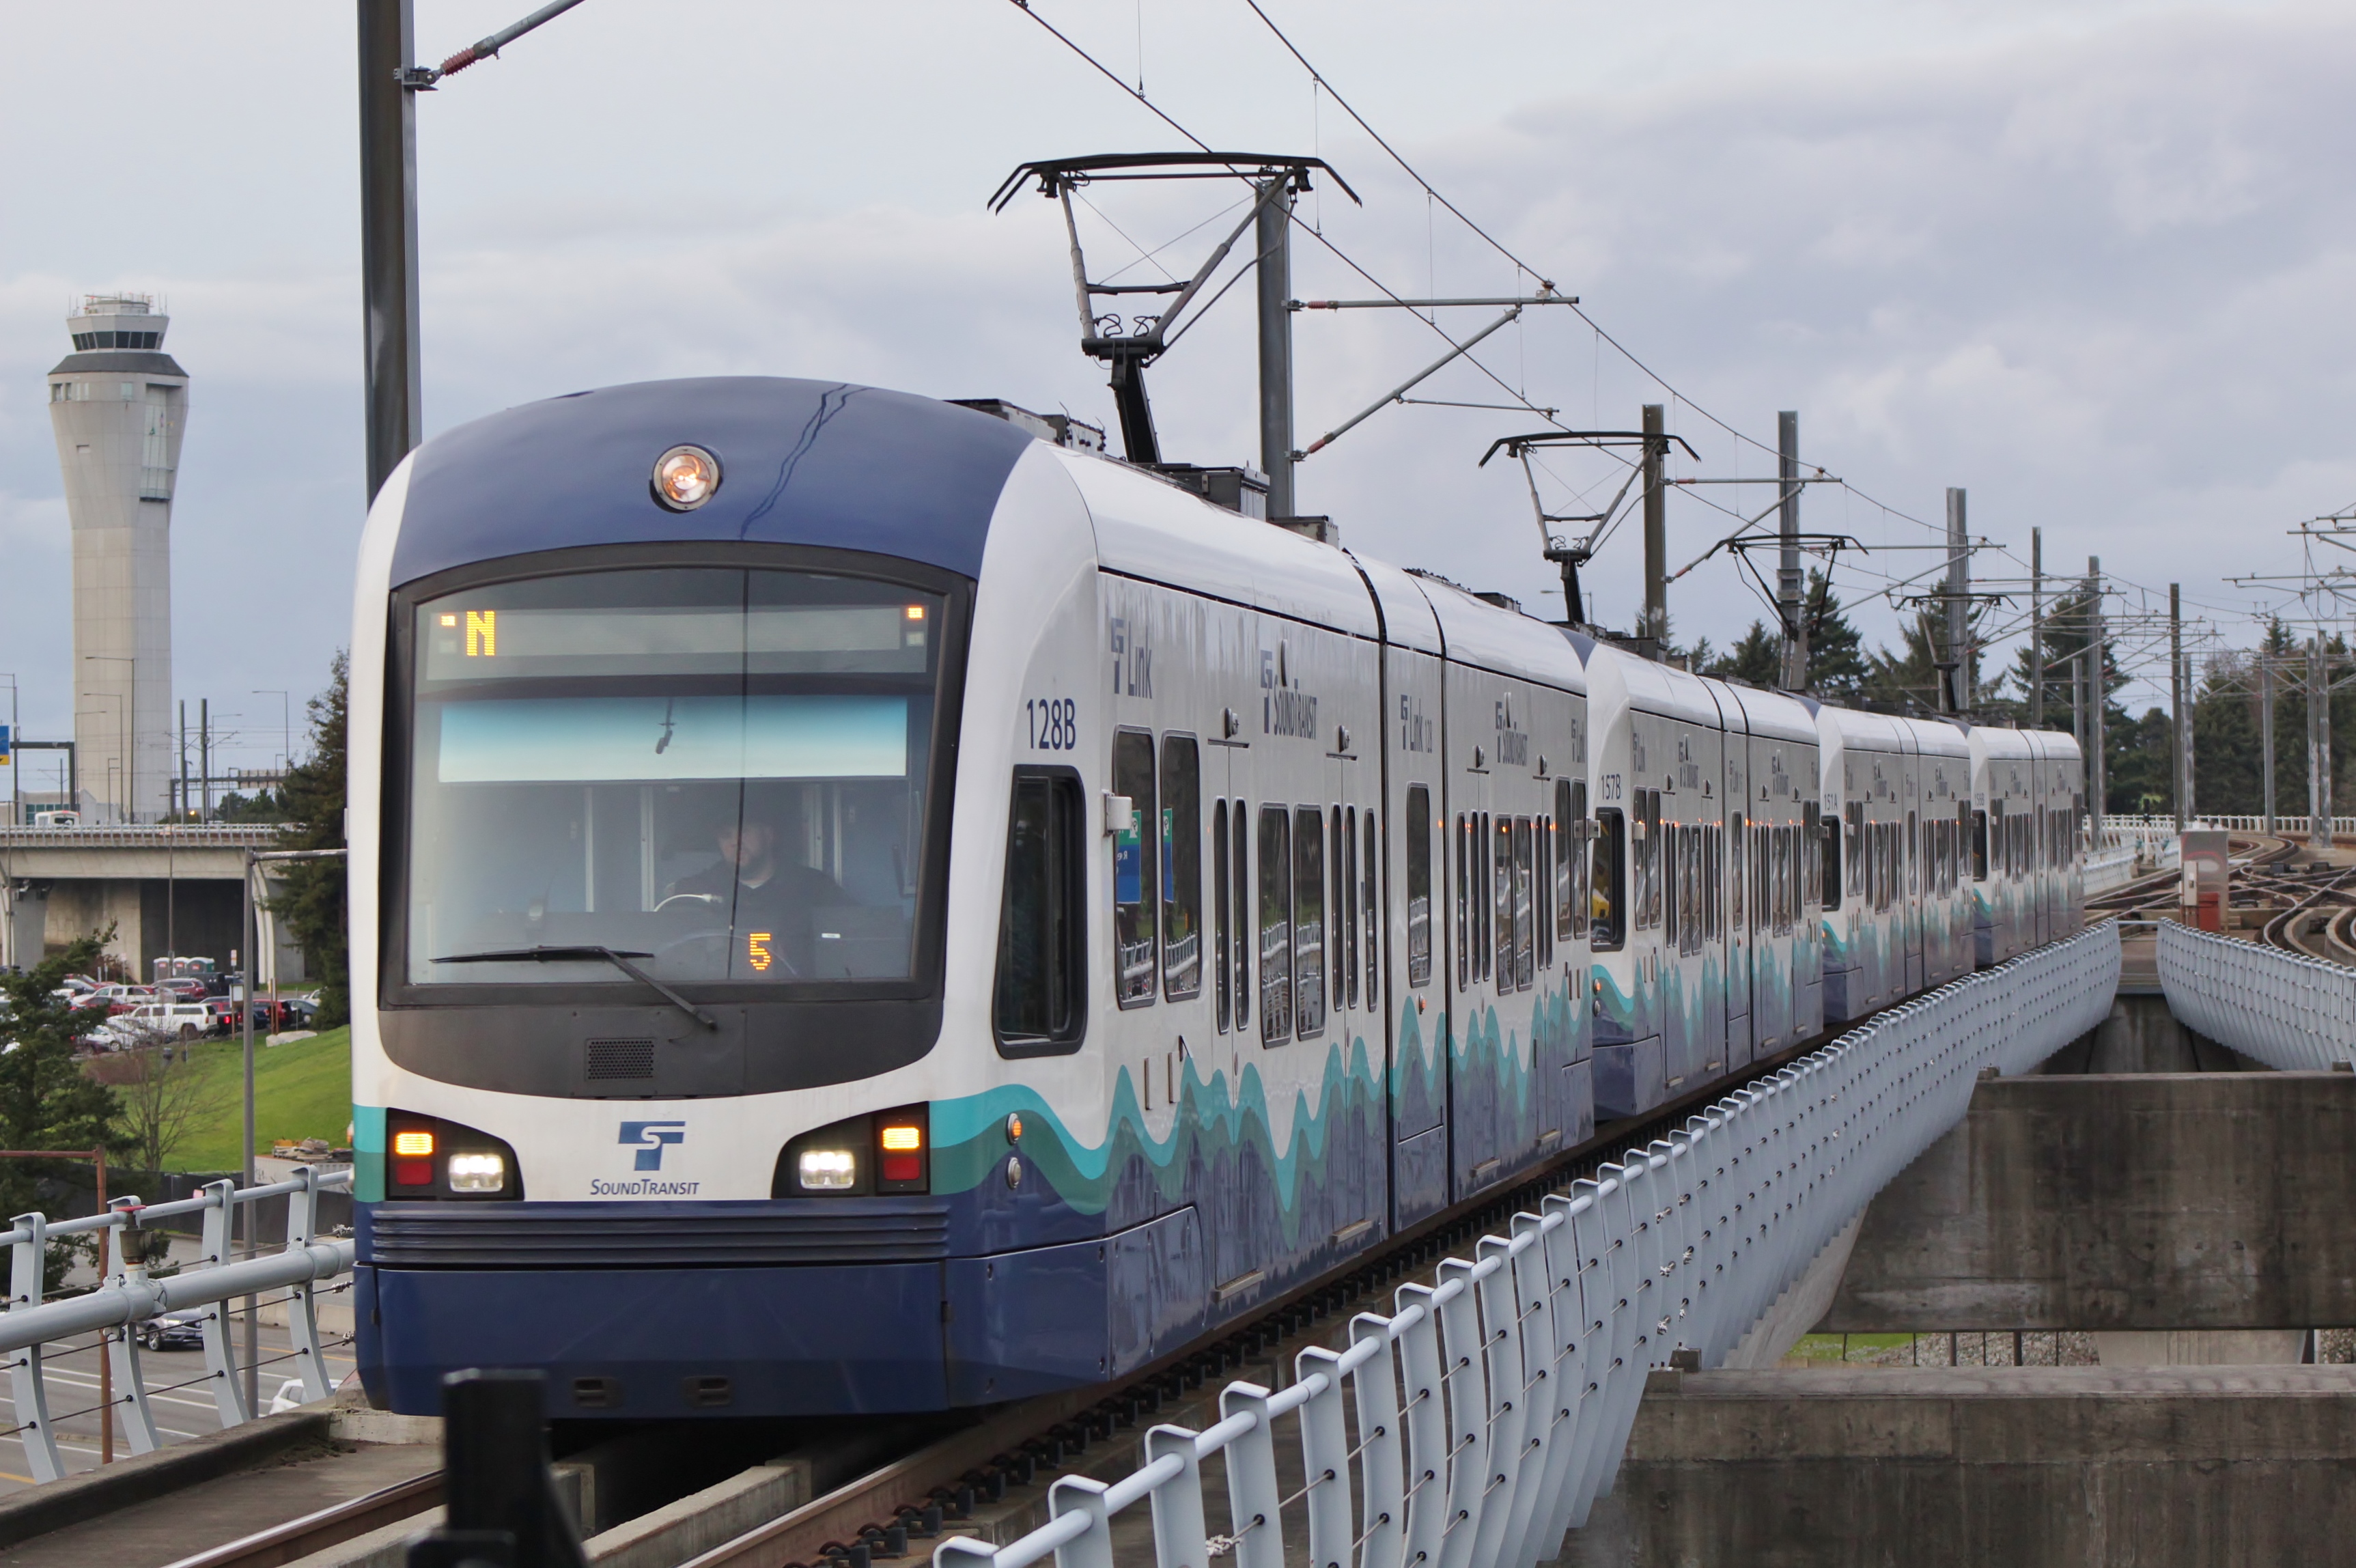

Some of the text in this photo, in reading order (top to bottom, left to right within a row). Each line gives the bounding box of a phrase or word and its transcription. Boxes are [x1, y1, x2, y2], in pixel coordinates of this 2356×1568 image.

[466, 611, 495, 656] N
[1128, 620, 1153, 699] Link
[1027, 698, 1076, 750] 128B
[1410, 695, 1423, 753] Link
[1601, 773, 1621, 800] 157B
[750, 933, 771, 970] 5
